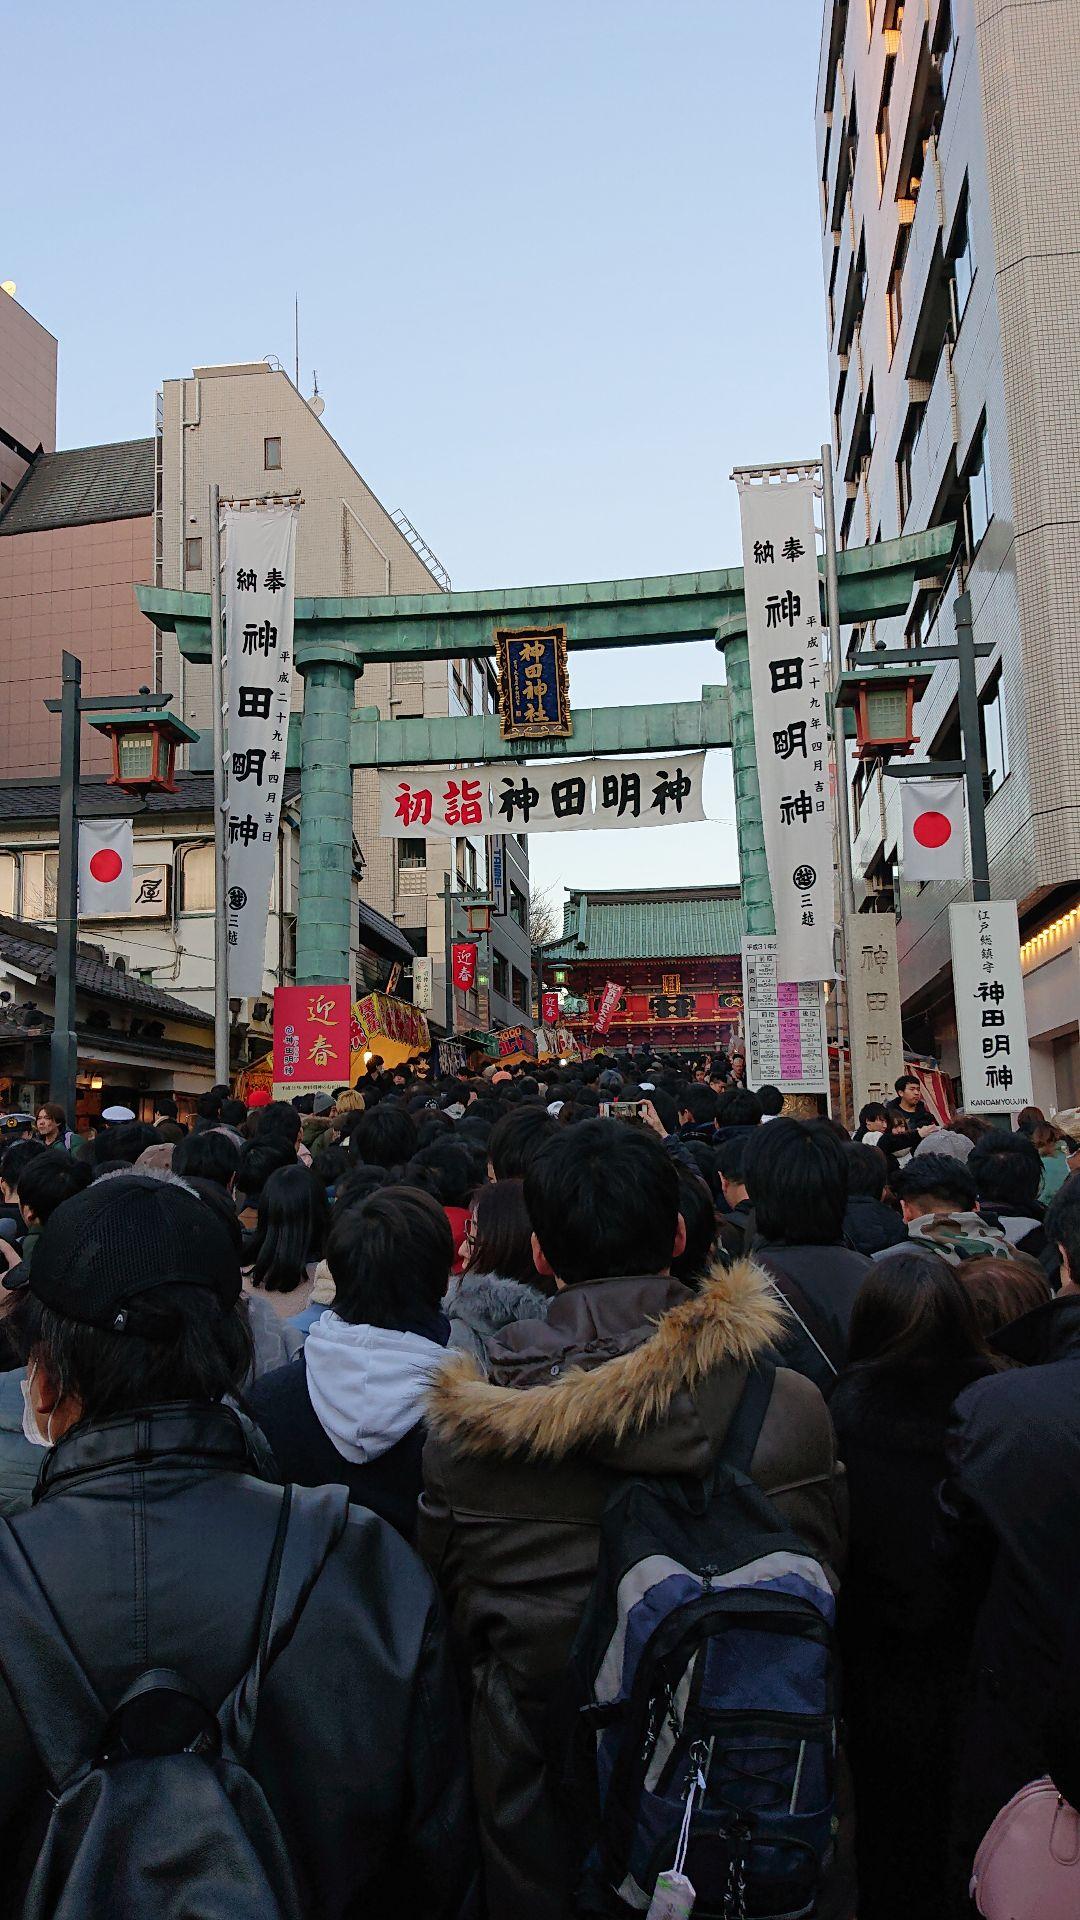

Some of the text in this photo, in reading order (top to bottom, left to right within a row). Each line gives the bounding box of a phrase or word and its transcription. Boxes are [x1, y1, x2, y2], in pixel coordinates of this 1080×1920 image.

[519, 640, 549, 722] 神田神社
[806, 615, 825, 813] 平成二十九年四月吉日
[262, 650, 291, 843] 平成二十九年四月吉日
[801, 893, 815, 926] 三越
[457, 950, 473, 982] 迎春
[306, 994, 339, 1067] 迎春
[545, 996, 556, 1017] 迎春
[973, 980, 1013, 1092] 神田明神
[283, 1035, 294, 1076] 神田明神
